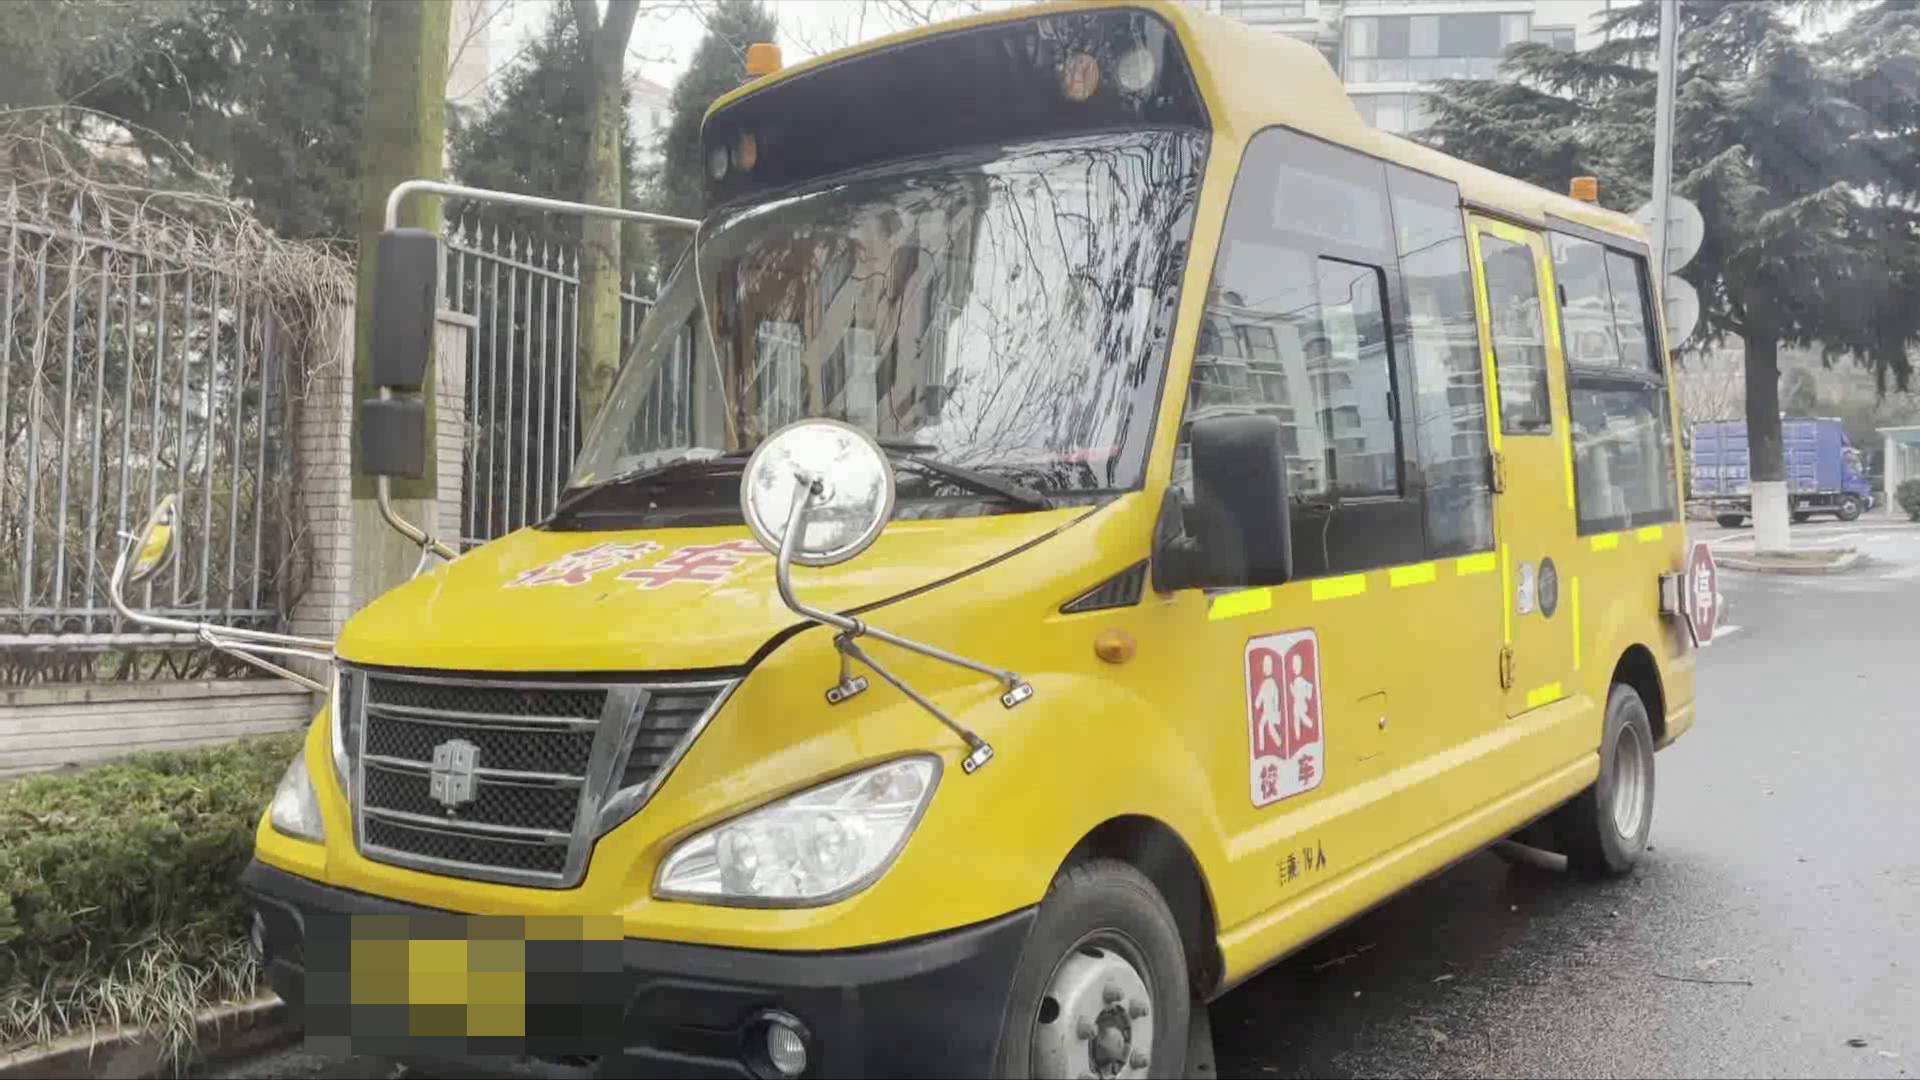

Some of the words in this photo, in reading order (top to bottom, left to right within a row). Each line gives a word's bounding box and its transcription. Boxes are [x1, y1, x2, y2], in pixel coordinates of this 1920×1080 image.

[503, 540, 770, 589] 校车
[1694, 562, 1712, 624] 停
[1260, 754, 1315, 799] 校车
